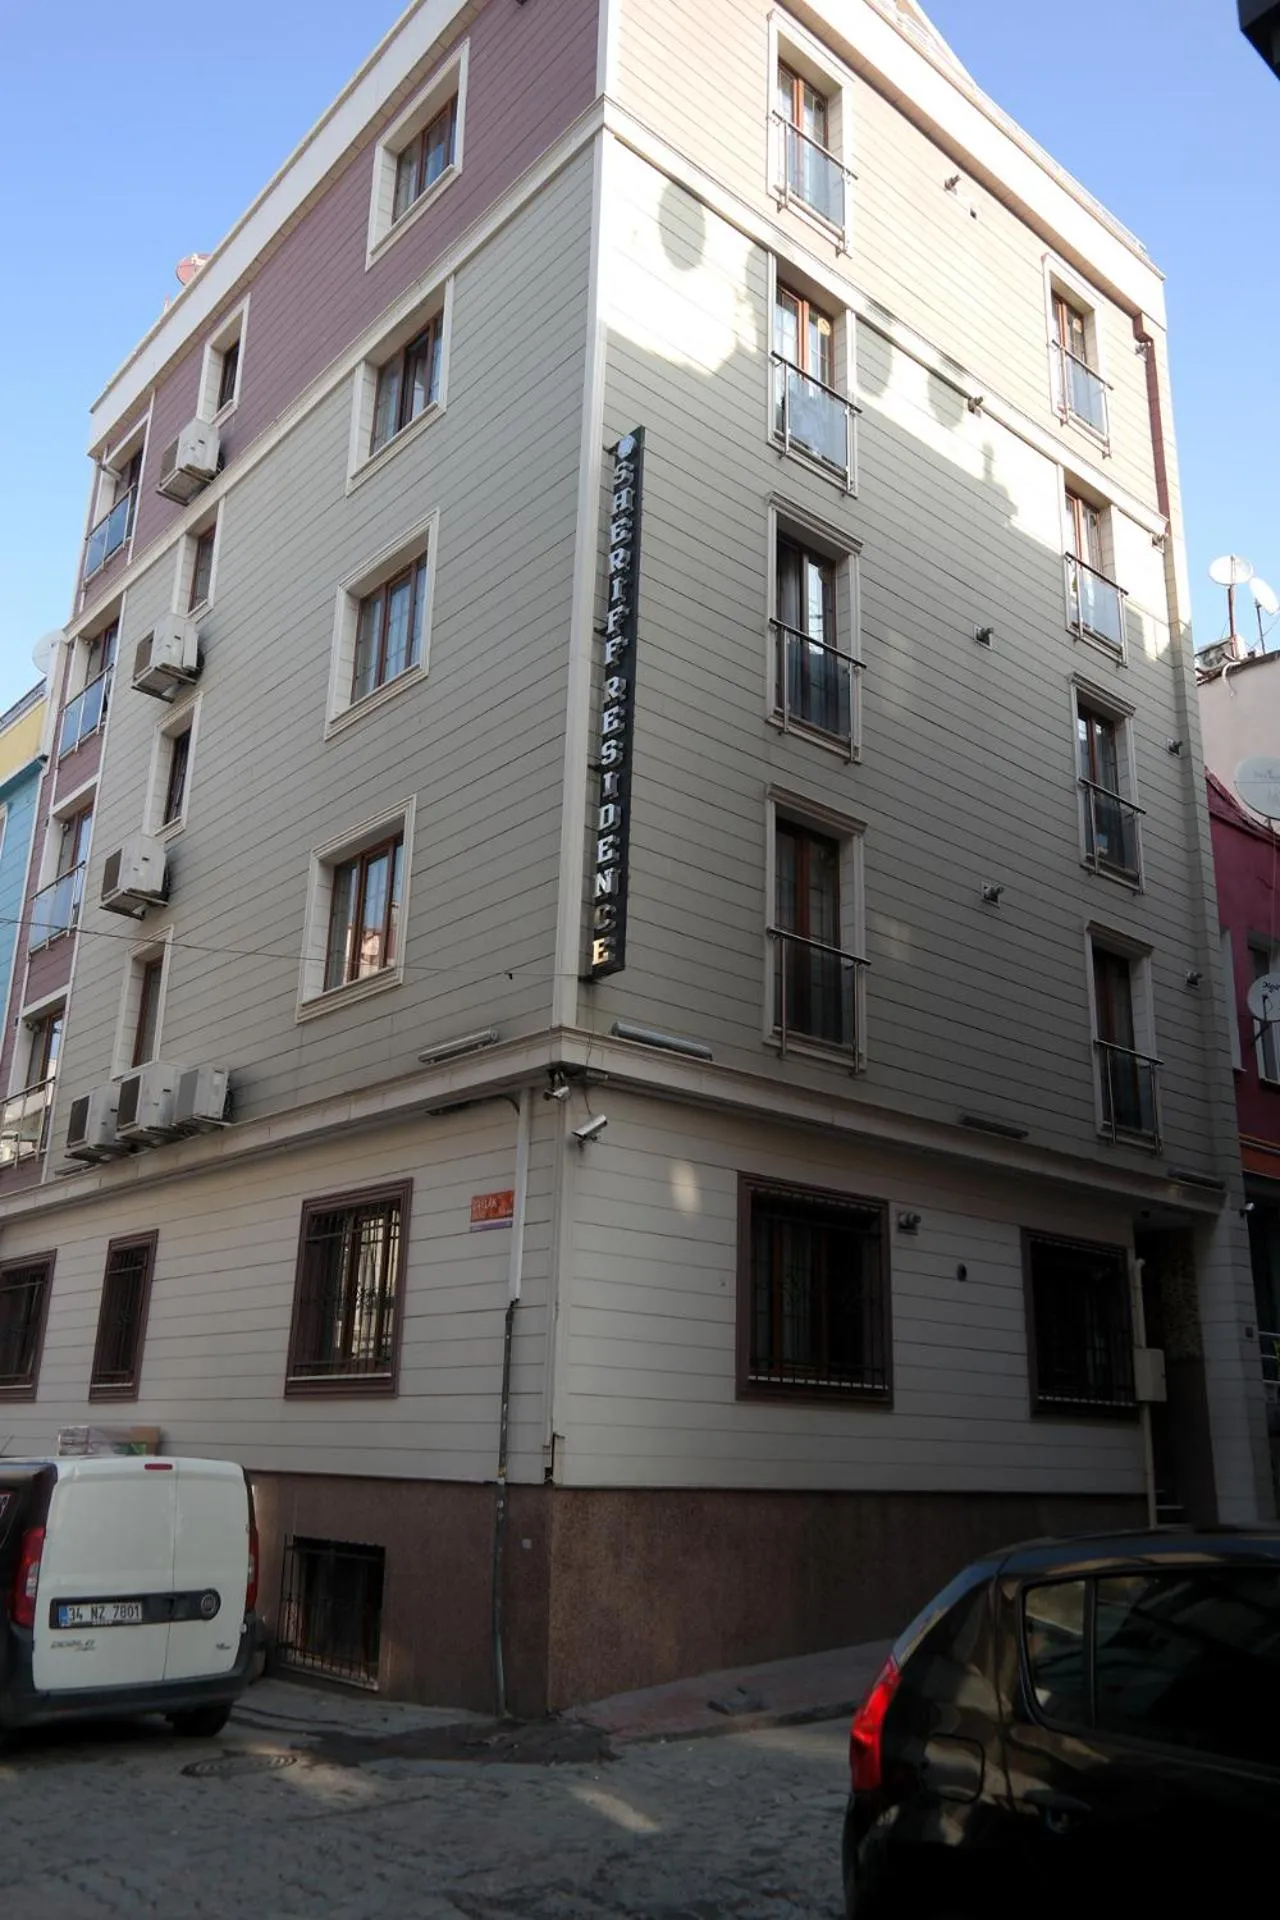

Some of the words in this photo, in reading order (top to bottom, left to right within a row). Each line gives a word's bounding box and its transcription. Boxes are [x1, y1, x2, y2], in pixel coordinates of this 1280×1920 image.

[604, 460, 635, 669] SHERIFF
[592, 675, 628, 966] RESIDENCE
[69, 1606, 83, 1621] 34
[91, 1605, 105, 1620] NZ
